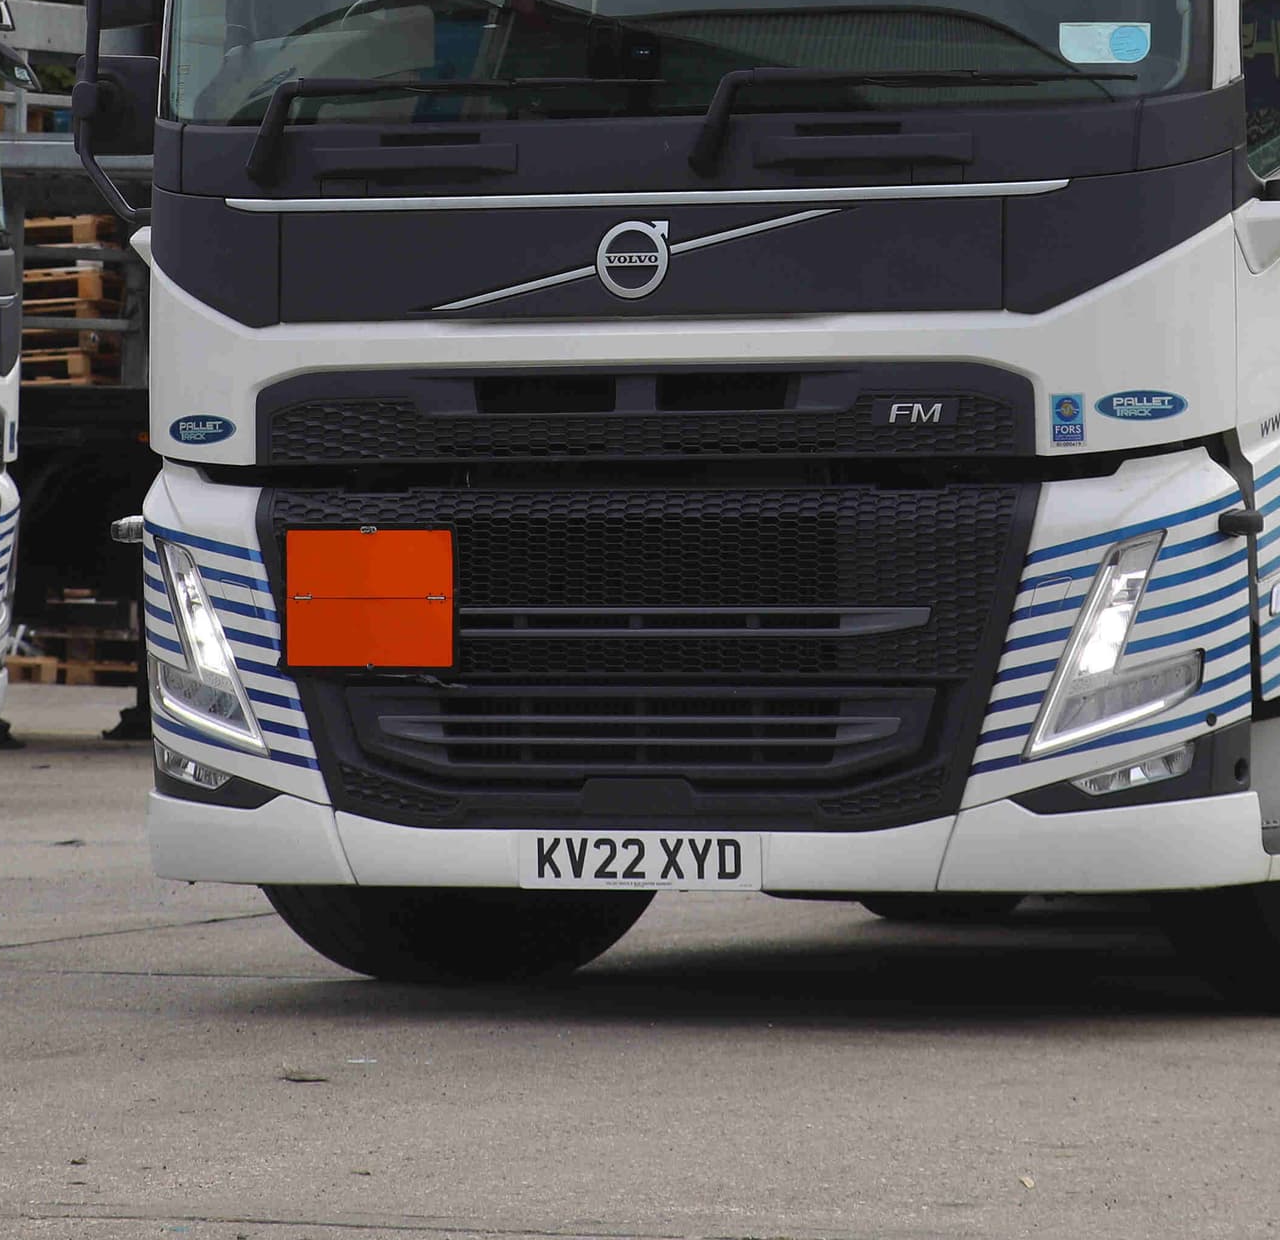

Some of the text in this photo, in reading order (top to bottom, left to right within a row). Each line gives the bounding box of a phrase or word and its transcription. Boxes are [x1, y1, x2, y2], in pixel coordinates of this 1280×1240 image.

[606, 255, 658, 264] VOLVO
[1113, 397, 1173, 407] PALLET
[889, 403, 942, 423] FM
[1115, 407, 1152, 416] TRACK
[180, 421, 223, 431] PALLET
[1055, 424, 1081, 434] FORS
[181, 432, 206, 441] TRACK
[537, 838, 741, 879] KV22 XYD
